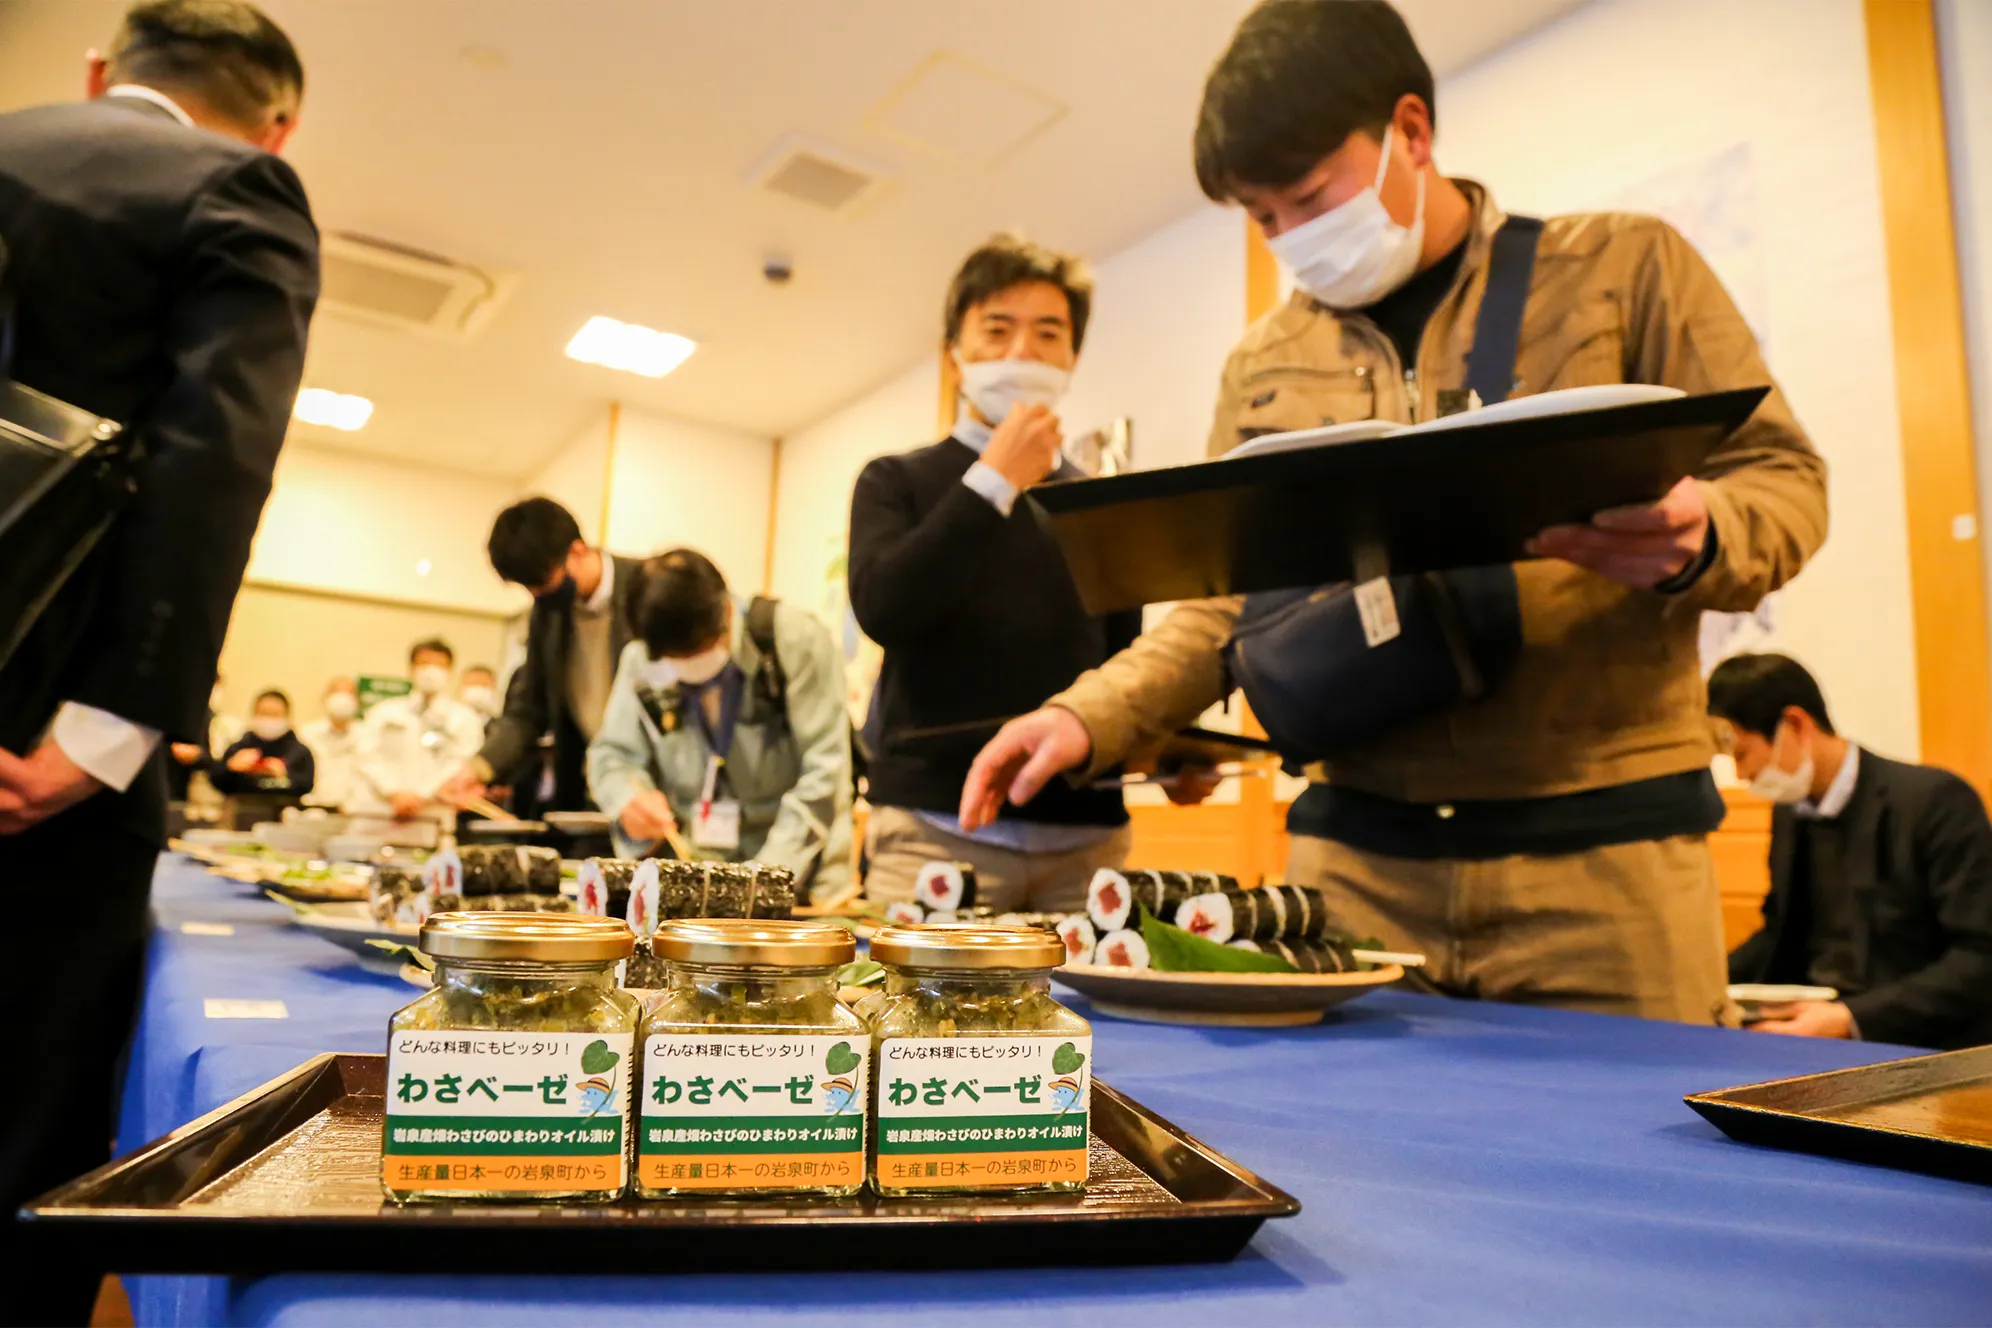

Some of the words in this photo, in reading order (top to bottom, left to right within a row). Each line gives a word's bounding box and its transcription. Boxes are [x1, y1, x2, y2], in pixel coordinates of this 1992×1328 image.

[398, 1164, 607, 1181] 生産量日本一の岩泉町から
[654, 1161, 850, 1179] 生産量日本一の岩泉町から
[892, 1157, 1077, 1178] 生産量日本一の岩泉町から
